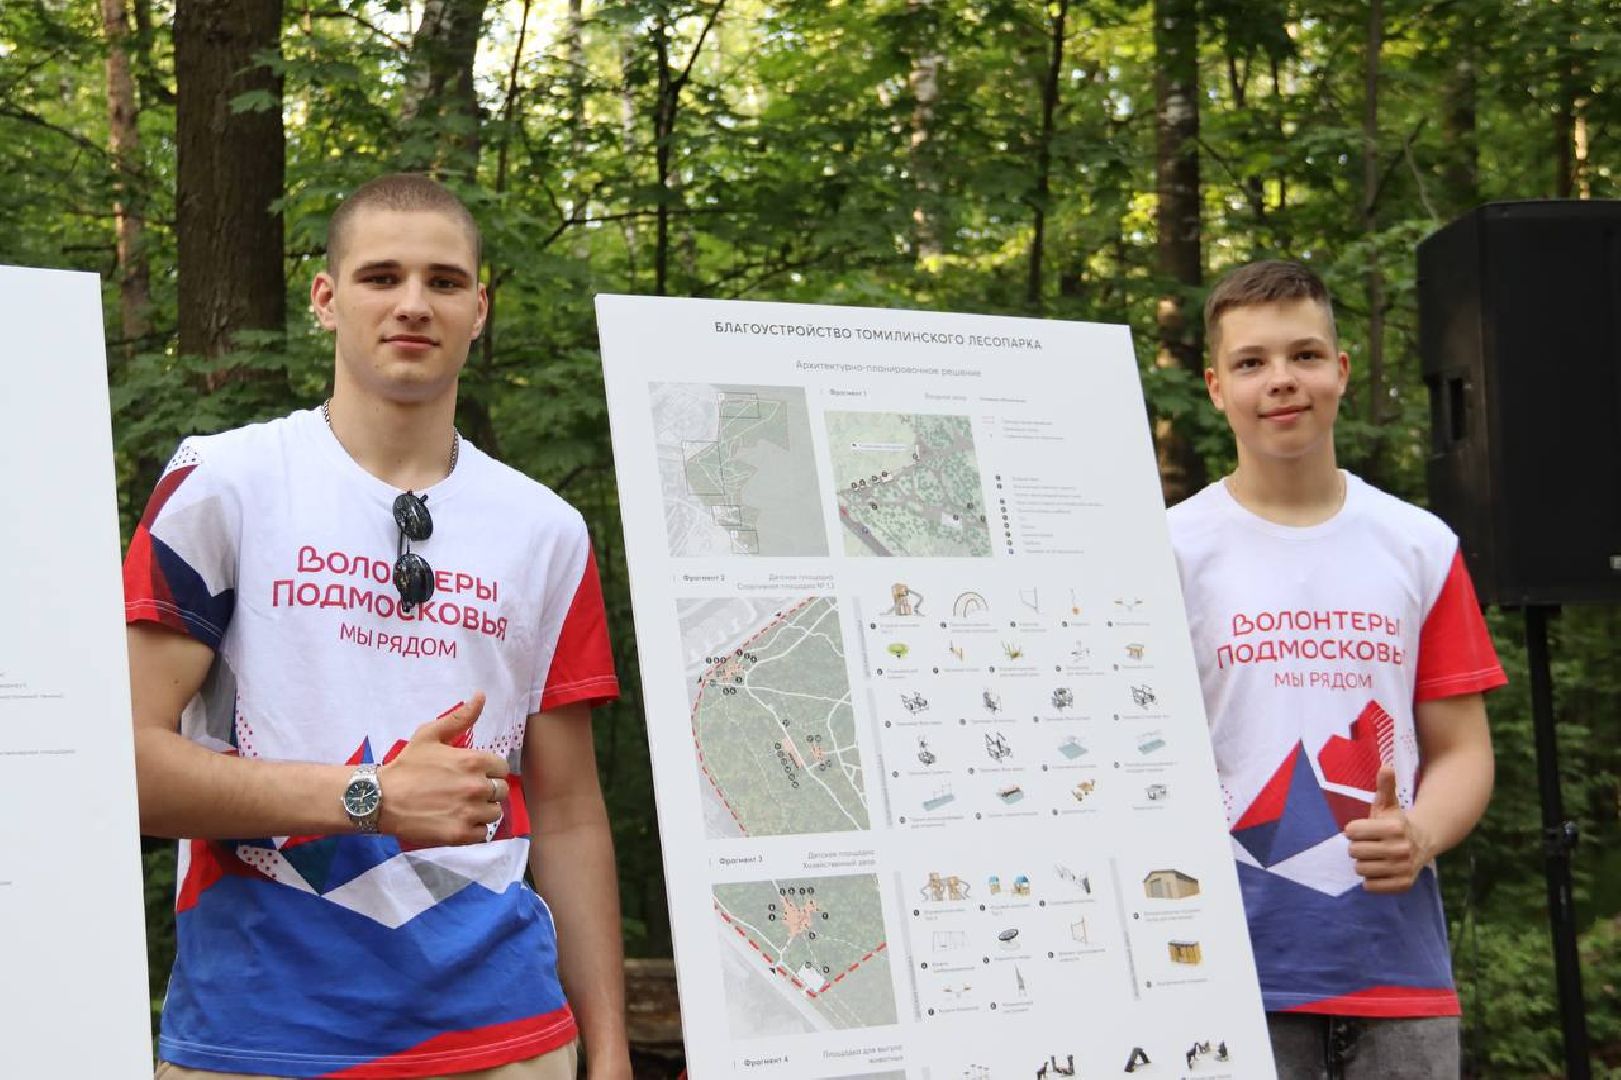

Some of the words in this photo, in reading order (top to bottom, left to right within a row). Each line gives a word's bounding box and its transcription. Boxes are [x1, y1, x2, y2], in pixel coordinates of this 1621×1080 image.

[715, 321, 852, 339] БЛАГОУСТРОЙСТВО
[856, 329, 964, 345] ТОМИЛИНСКОГО
[968, 335, 1043, 350] ЛЕСОПАРКА
[296, 545, 498, 602] ВОЛОЕРЫ
[272, 579, 508, 641] ПОДМОСКОВЬЯ
[1233, 610, 1400, 636] ВОЛОНТЕРЫ
[339, 622, 373, 647] МЫ
[377, 634, 457, 659] РЯДОМ
[1274, 672, 1304, 688] МЫ
[1309, 671, 1372, 691] РЯДОМ
